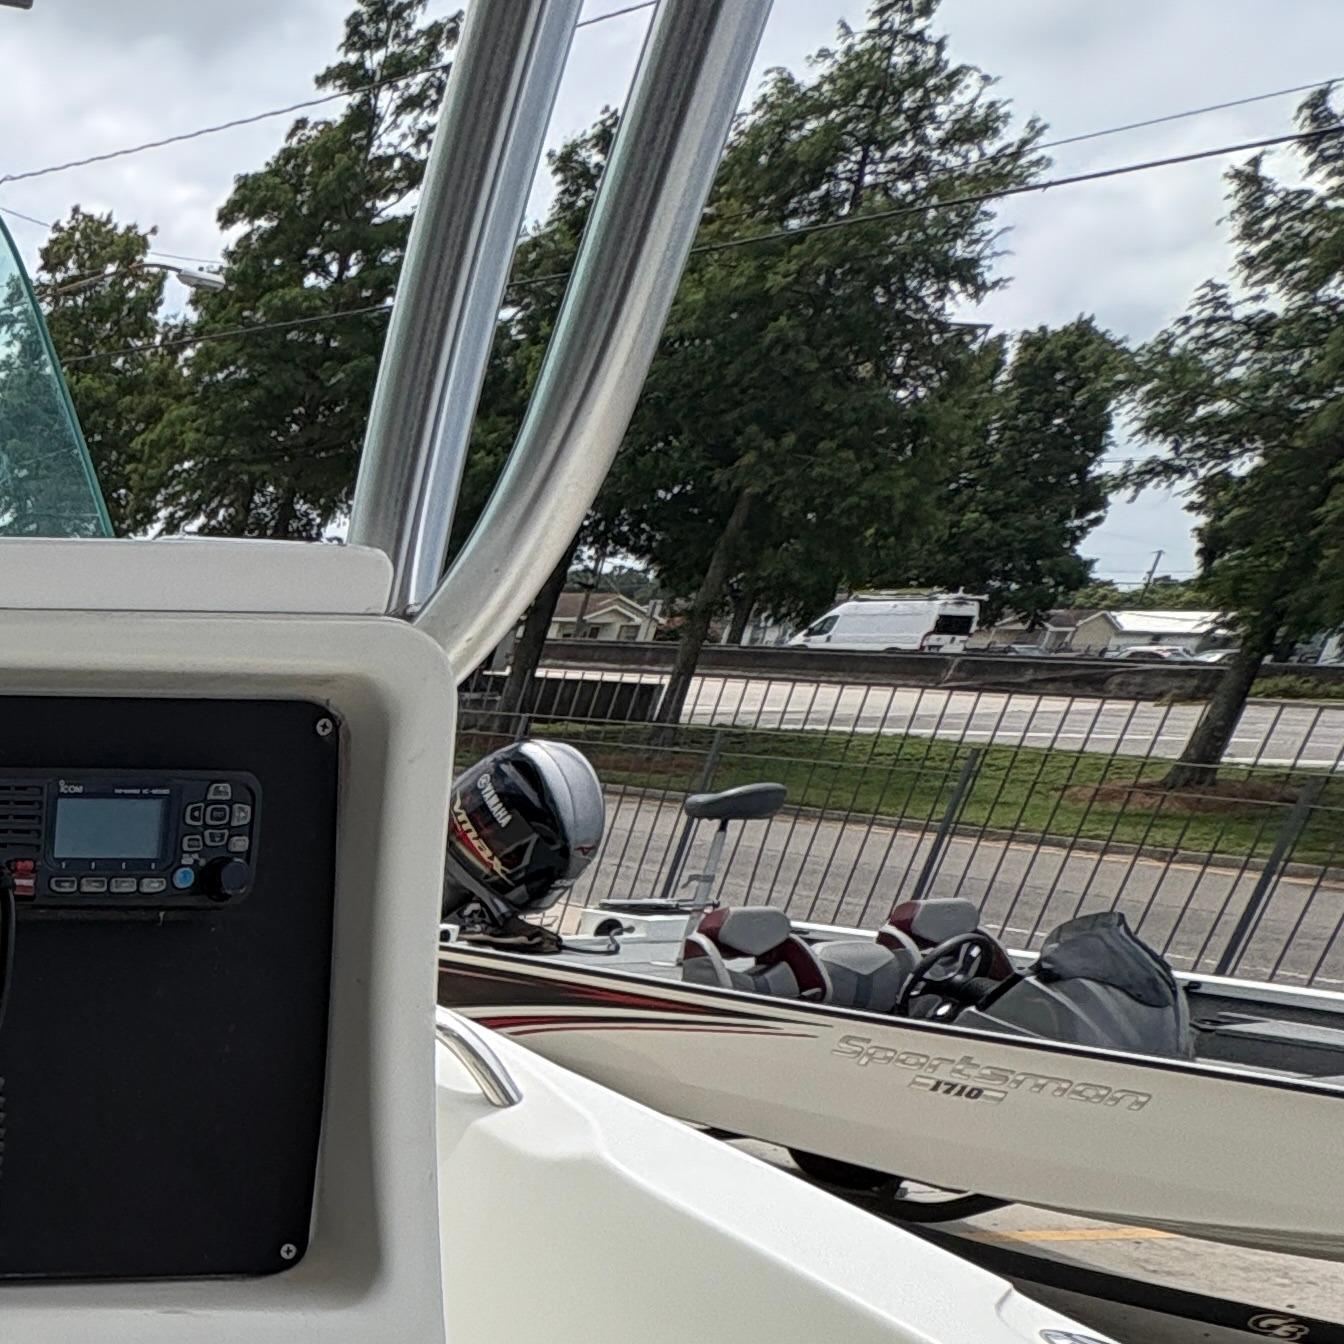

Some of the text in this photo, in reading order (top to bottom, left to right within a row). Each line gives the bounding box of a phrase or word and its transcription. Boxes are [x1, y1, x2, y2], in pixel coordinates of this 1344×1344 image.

[480, 782, 513, 829] YAMAHA
[831, 1034, 1153, 1111] Sportsman
[929, 1080, 984, 1100] 1710
